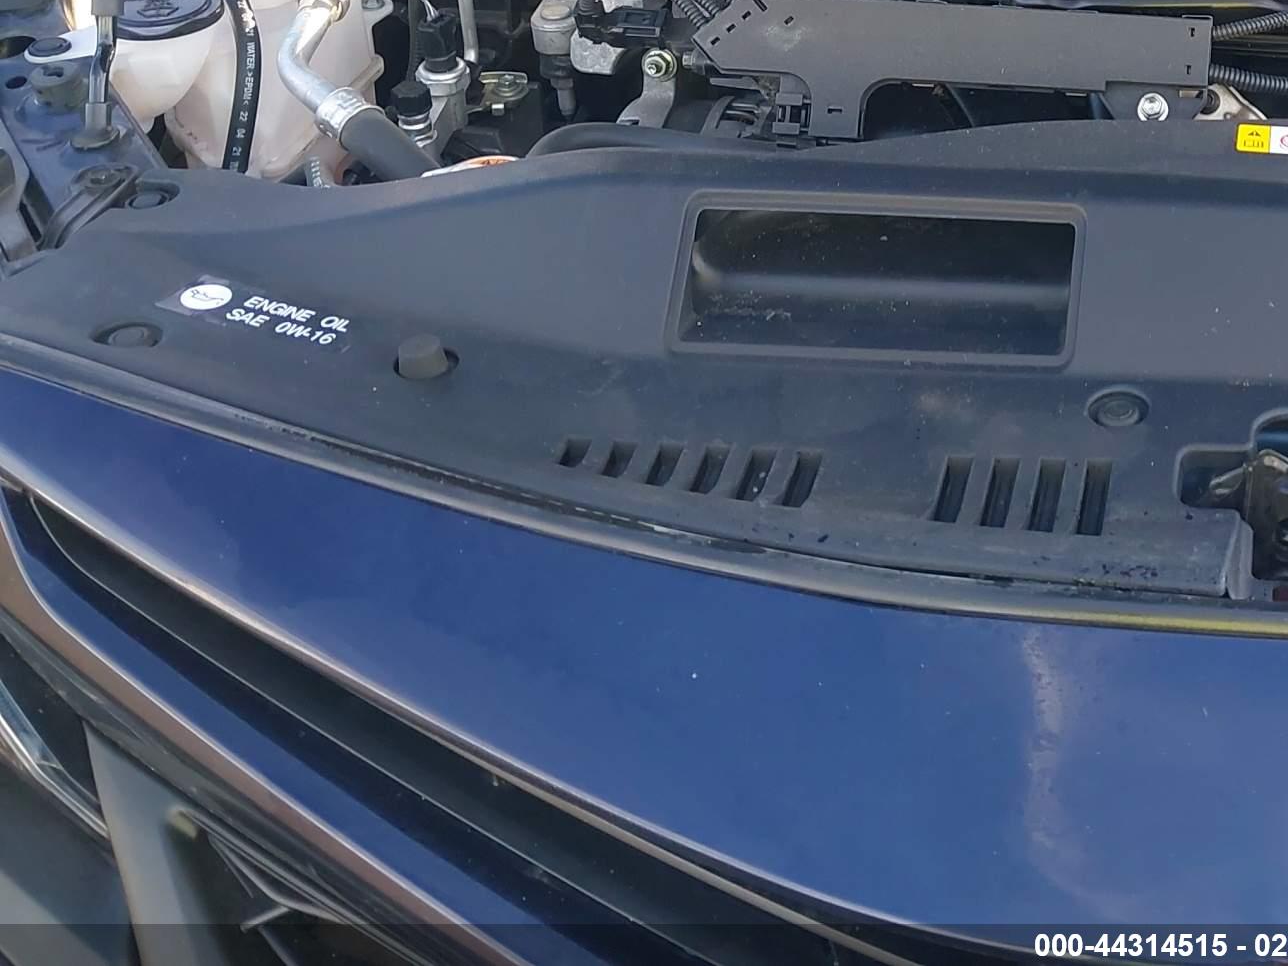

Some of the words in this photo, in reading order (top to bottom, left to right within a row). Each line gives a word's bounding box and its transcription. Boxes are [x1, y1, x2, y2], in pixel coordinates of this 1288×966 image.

[246, 41, 256, 70] WATER
[239, 110, 249, 122] 22
[225, 308, 270, 328] SAE
[243, 296, 316, 322] ENGINE
[320, 315, 351, 333] OIL
